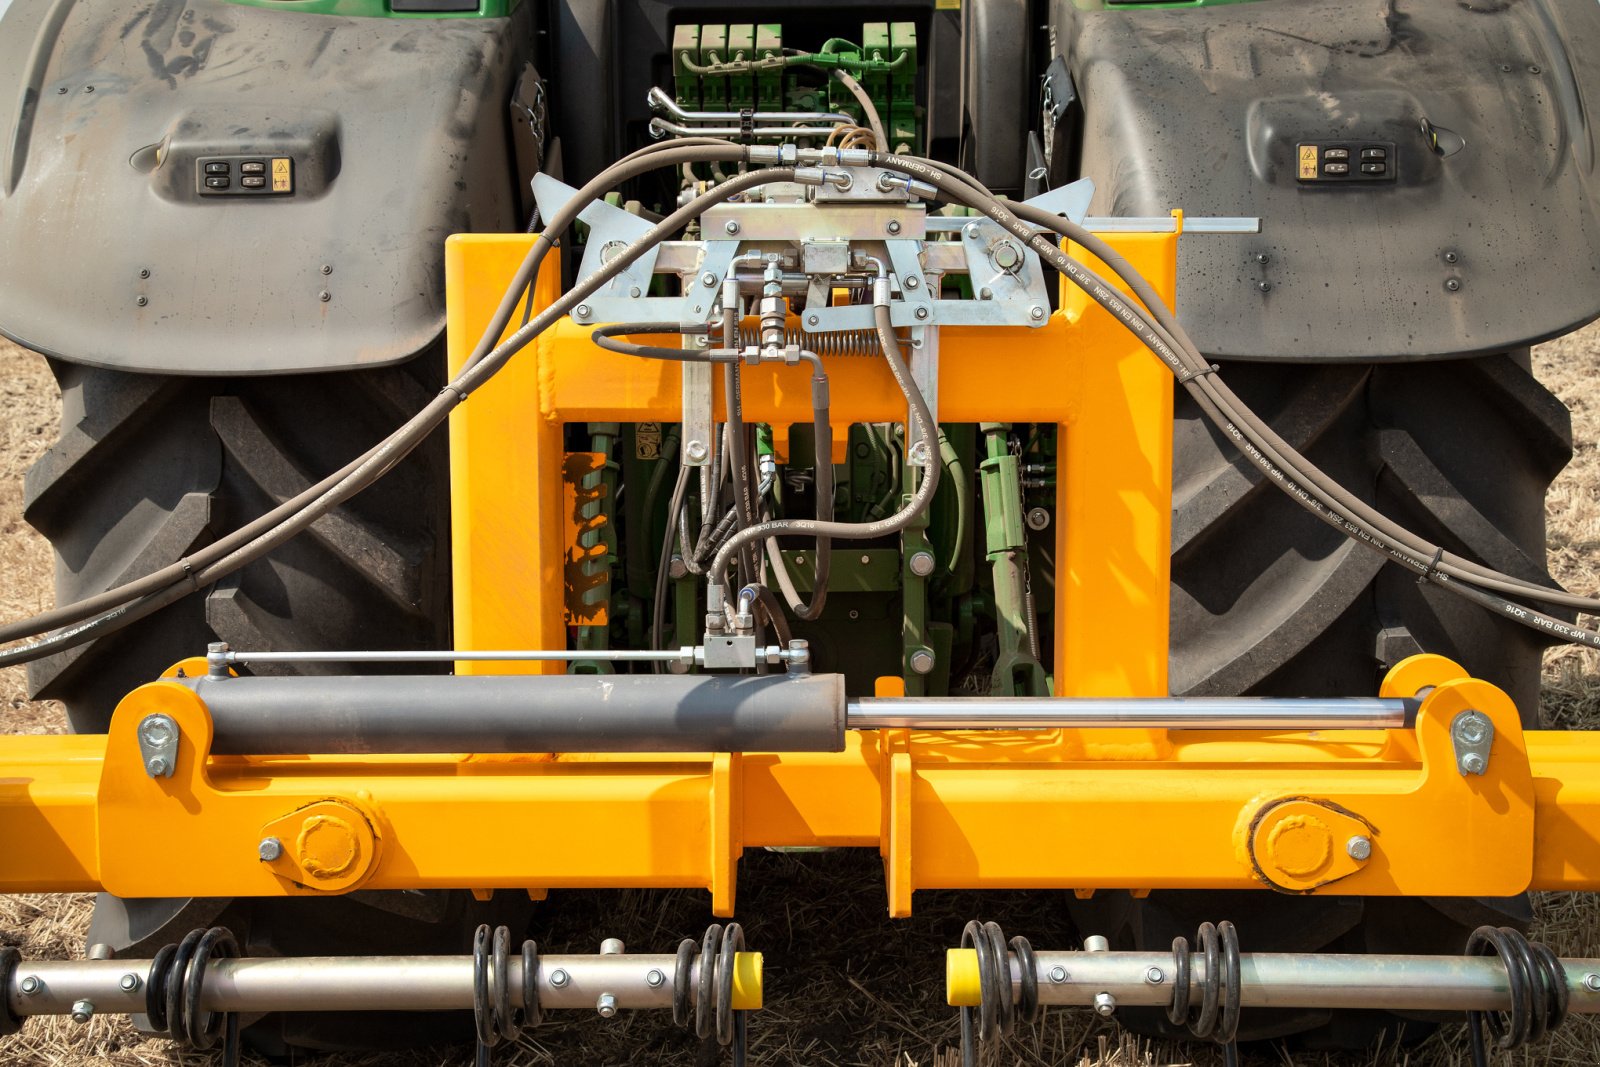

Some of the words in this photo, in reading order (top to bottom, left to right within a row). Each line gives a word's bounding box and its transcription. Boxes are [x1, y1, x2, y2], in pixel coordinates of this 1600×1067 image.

[885, 155, 926, 173] GERMANY
[930, 170, 942, 180] SH
[990, 205, 1009, 221] 3Q16
[1012, 222, 1029, 236] BAR
[1040, 241, 1054, 256] WP
[1057, 256, 1066, 265] 10
[1065, 262, 1077, 274] DN
[1093, 286, 1110, 301] 2SN
[1108, 296, 1121, 311] 853
[1119, 308, 1132, 322] EN
[1130, 317, 1144, 332] DIN
[1145, 333, 1180, 366] GERMANY
[910, 403, 917, 412] 10
[914, 412, 923, 424] DN
[1244, 443, 1261, 461] BAR
[1259, 457, 1273, 471] 330
[923, 475, 931, 487] EN
[1271, 468, 1284, 481] WP
[917, 486, 927, 500] DIN
[1287, 481, 1297, 491] 10
[1295, 489, 1309, 500] DN
[884, 502, 916, 528] GERMANY
[1327, 510, 1345, 524] 2SN
[869, 523, 880, 531] SH
[720, 542, 730, 554] DN
[730, 537, 738, 545] 10
[742, 527, 756, 537] WP
[771, 521, 789, 529] BAR
[1357, 530, 1371, 541] EN
[1369, 537, 1385, 549] DIN
[1436, 571, 1449, 581] SH
[1505, 603, 1528, 619] 3Q16
[1533, 615, 1553, 628] BAR
[1552, 622, 1570, 634] 330
[1569, 627, 1586, 641] WP
